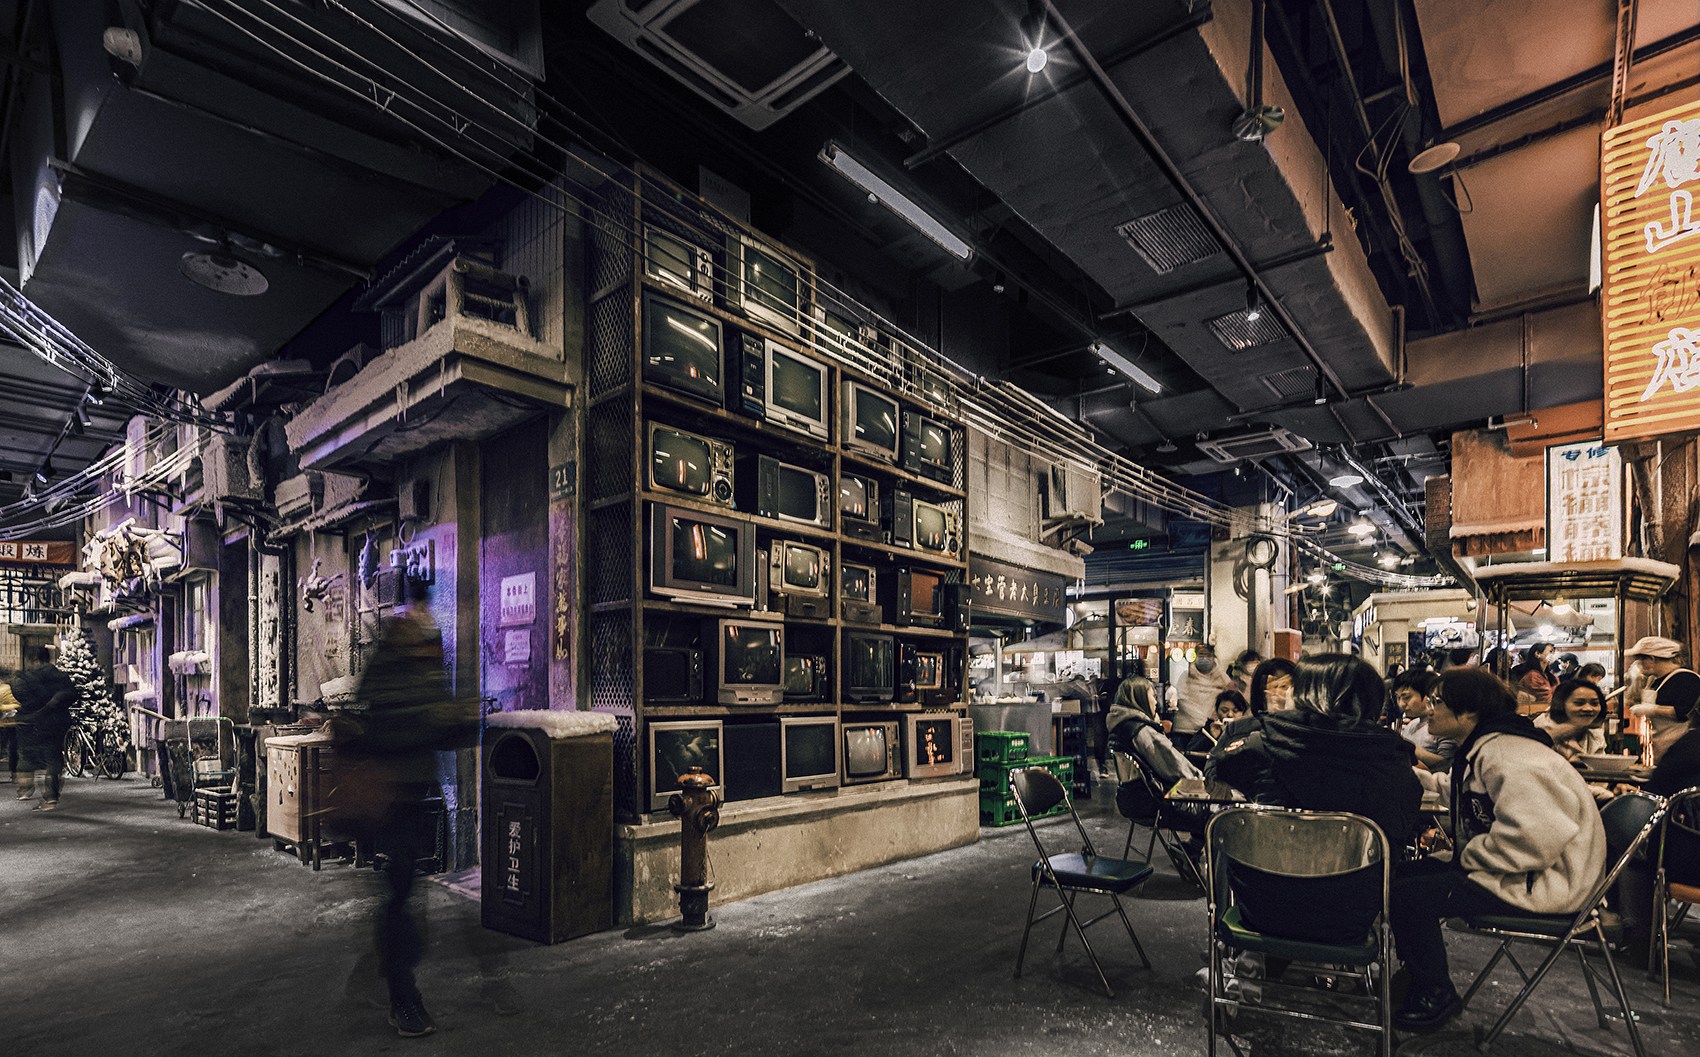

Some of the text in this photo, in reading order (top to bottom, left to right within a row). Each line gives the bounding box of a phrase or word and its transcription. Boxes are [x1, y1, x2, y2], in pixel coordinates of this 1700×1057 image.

[556, 468, 568, 489] 21
[507, 821, 521, 892] 爱护卫生
